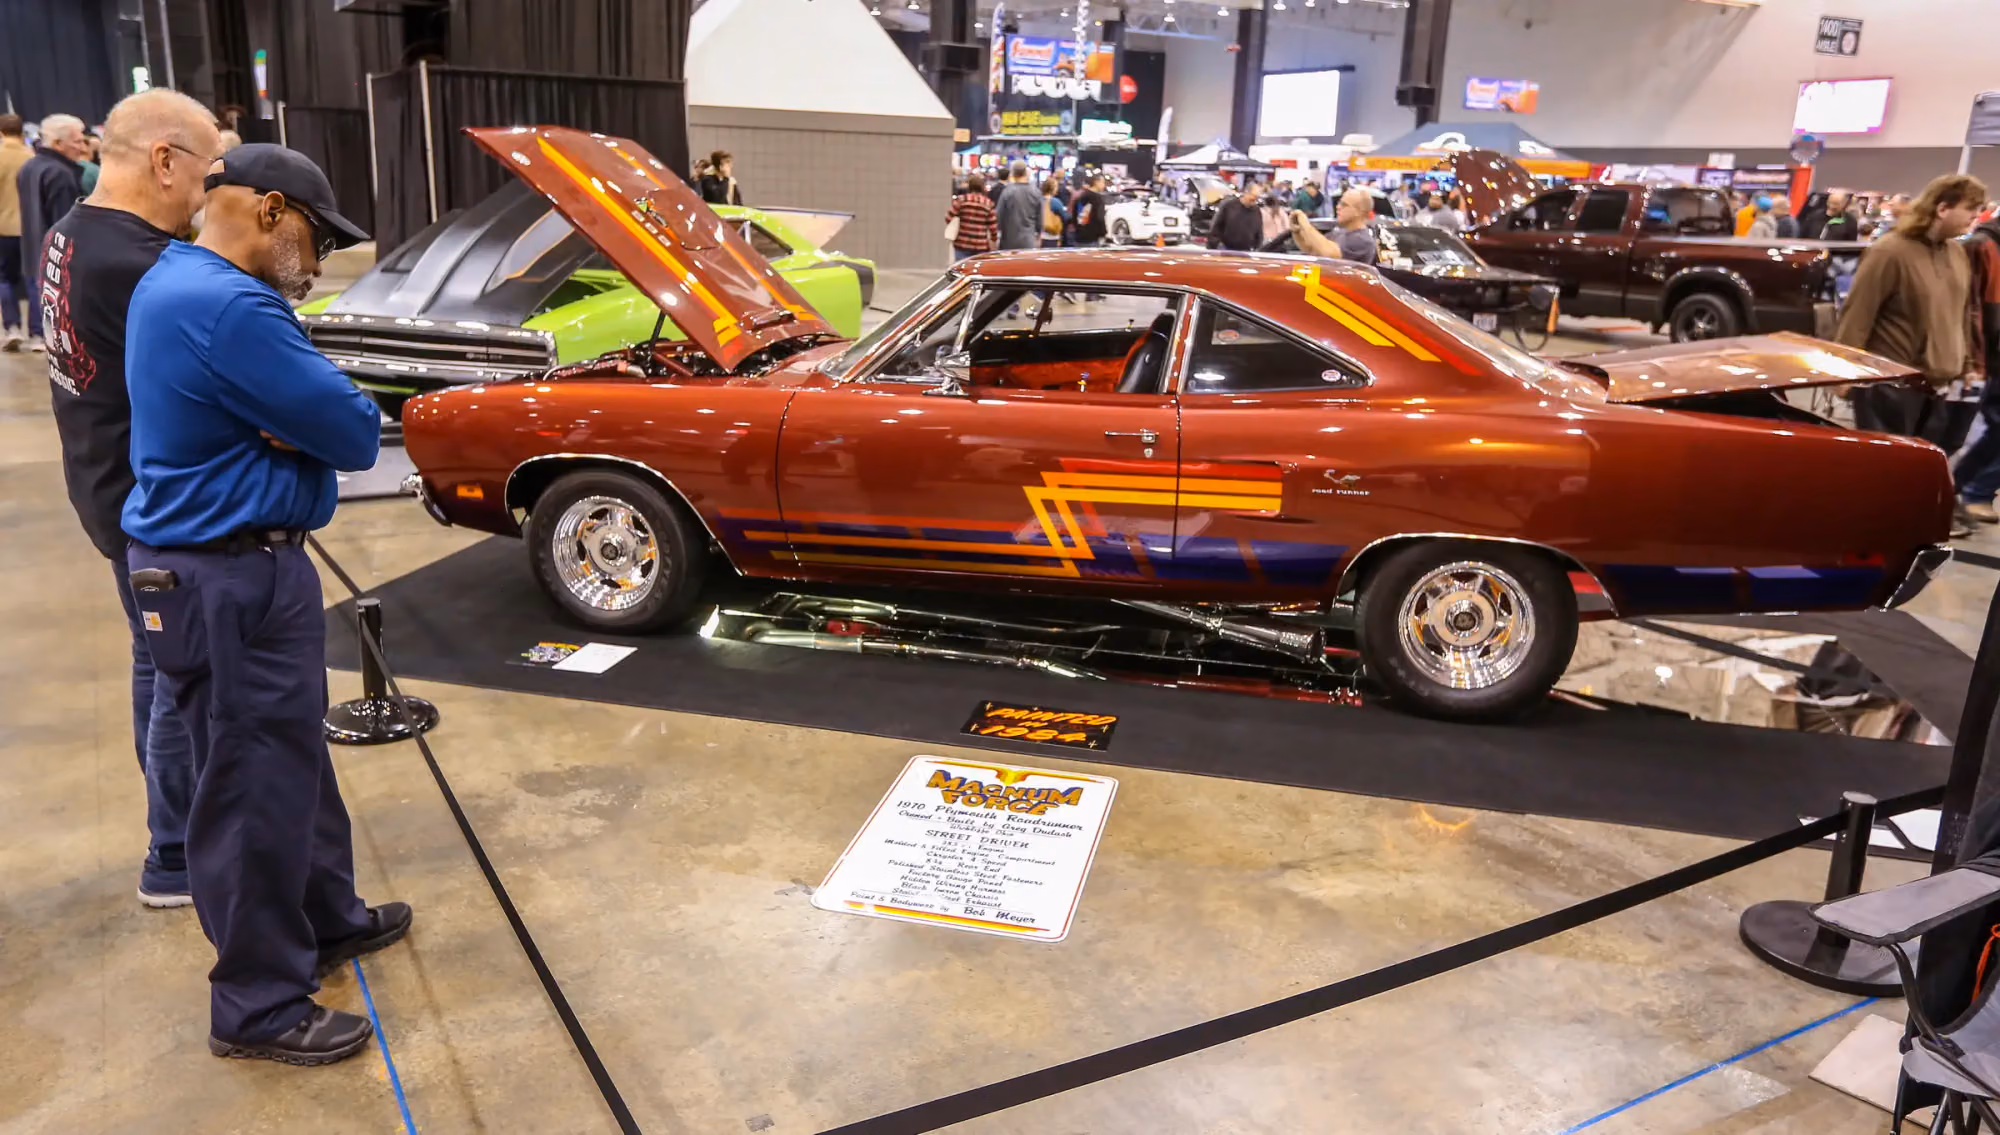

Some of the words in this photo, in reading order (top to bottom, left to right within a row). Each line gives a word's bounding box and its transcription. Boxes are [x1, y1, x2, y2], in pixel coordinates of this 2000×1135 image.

[46, 261, 61, 285] OLD
[985, 707, 1118, 726] PAINTED
[978, 725, 1088, 743] 1984
[926, 770, 1084, 806] MAGNUM
[942, 789, 1058, 815] FORCE
[897, 800, 926, 810] 1970
[935, 805, 997, 819] Plymouth
[1006, 814, 1082, 830] Roadrunner
[898, 809, 933, 819] Owned
[946, 816, 975, 825] Built
[982, 820, 996, 829] by
[1001, 823, 1027, 833] Greg
[925, 829, 971, 840] STREET
[980, 836, 1029, 848] DRIVEN
[981, 858, 1007, 866] Speed
[983, 865, 1001, 873] End
[939, 904, 950, 912] by
[963, 906, 985, 916] Bob
[995, 911, 1035, 923] Meyer
